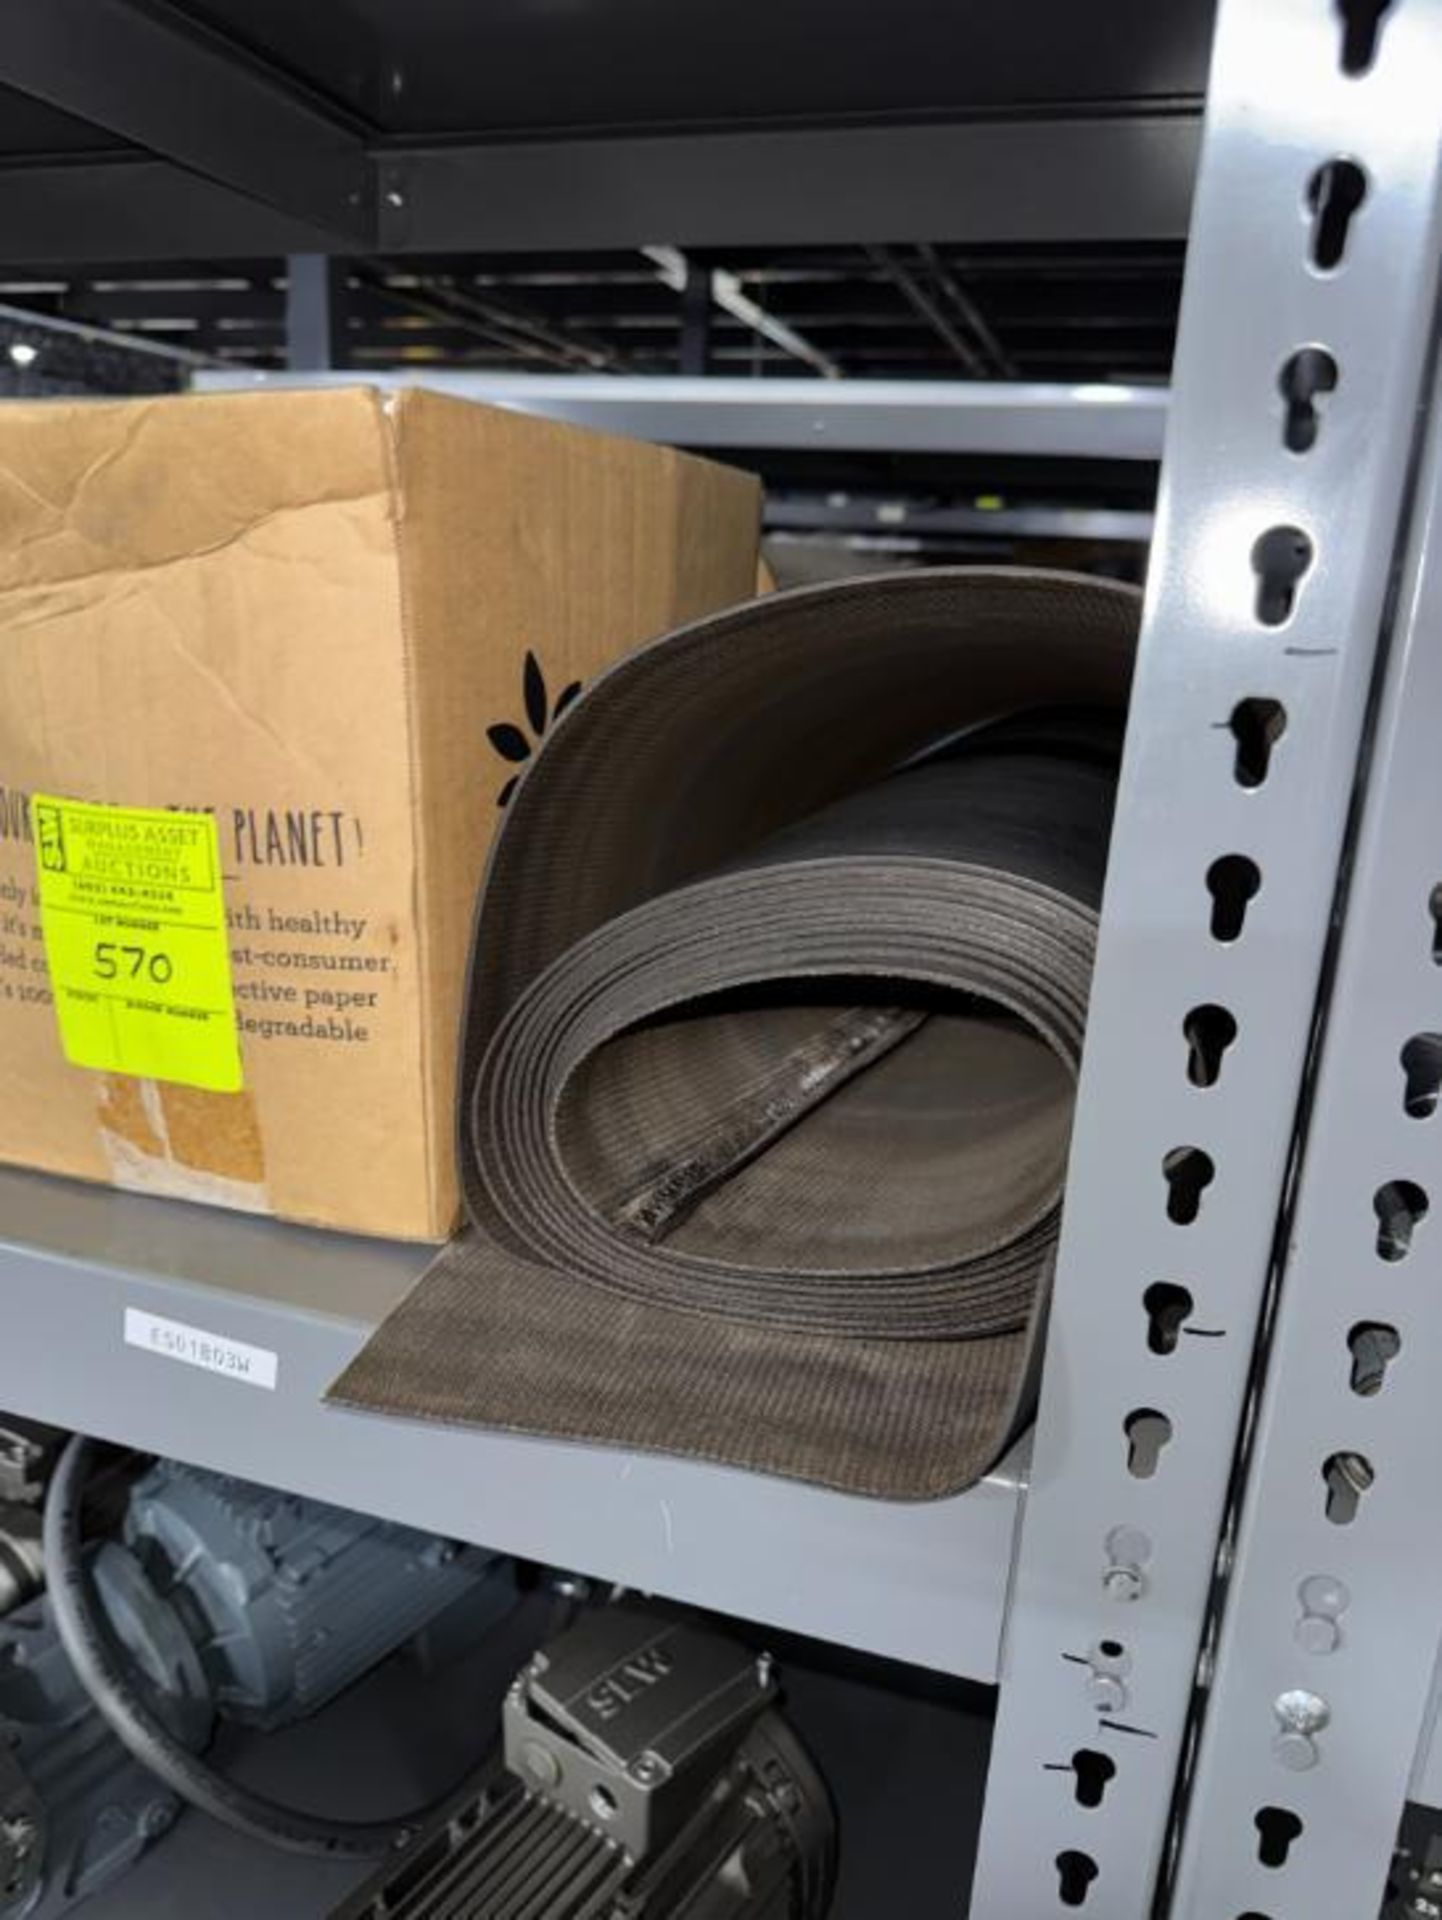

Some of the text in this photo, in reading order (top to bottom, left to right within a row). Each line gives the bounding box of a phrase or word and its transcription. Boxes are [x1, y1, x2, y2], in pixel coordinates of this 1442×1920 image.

[69, 816, 199, 848] SURPLUS ASSET
[82, 856, 192, 884] AUCTIONS
[227, 904, 260, 931] ith
[268, 909, 369, 939] healthy
[94, 942, 173, 984] 570
[305, 988, 378, 1011] paper
